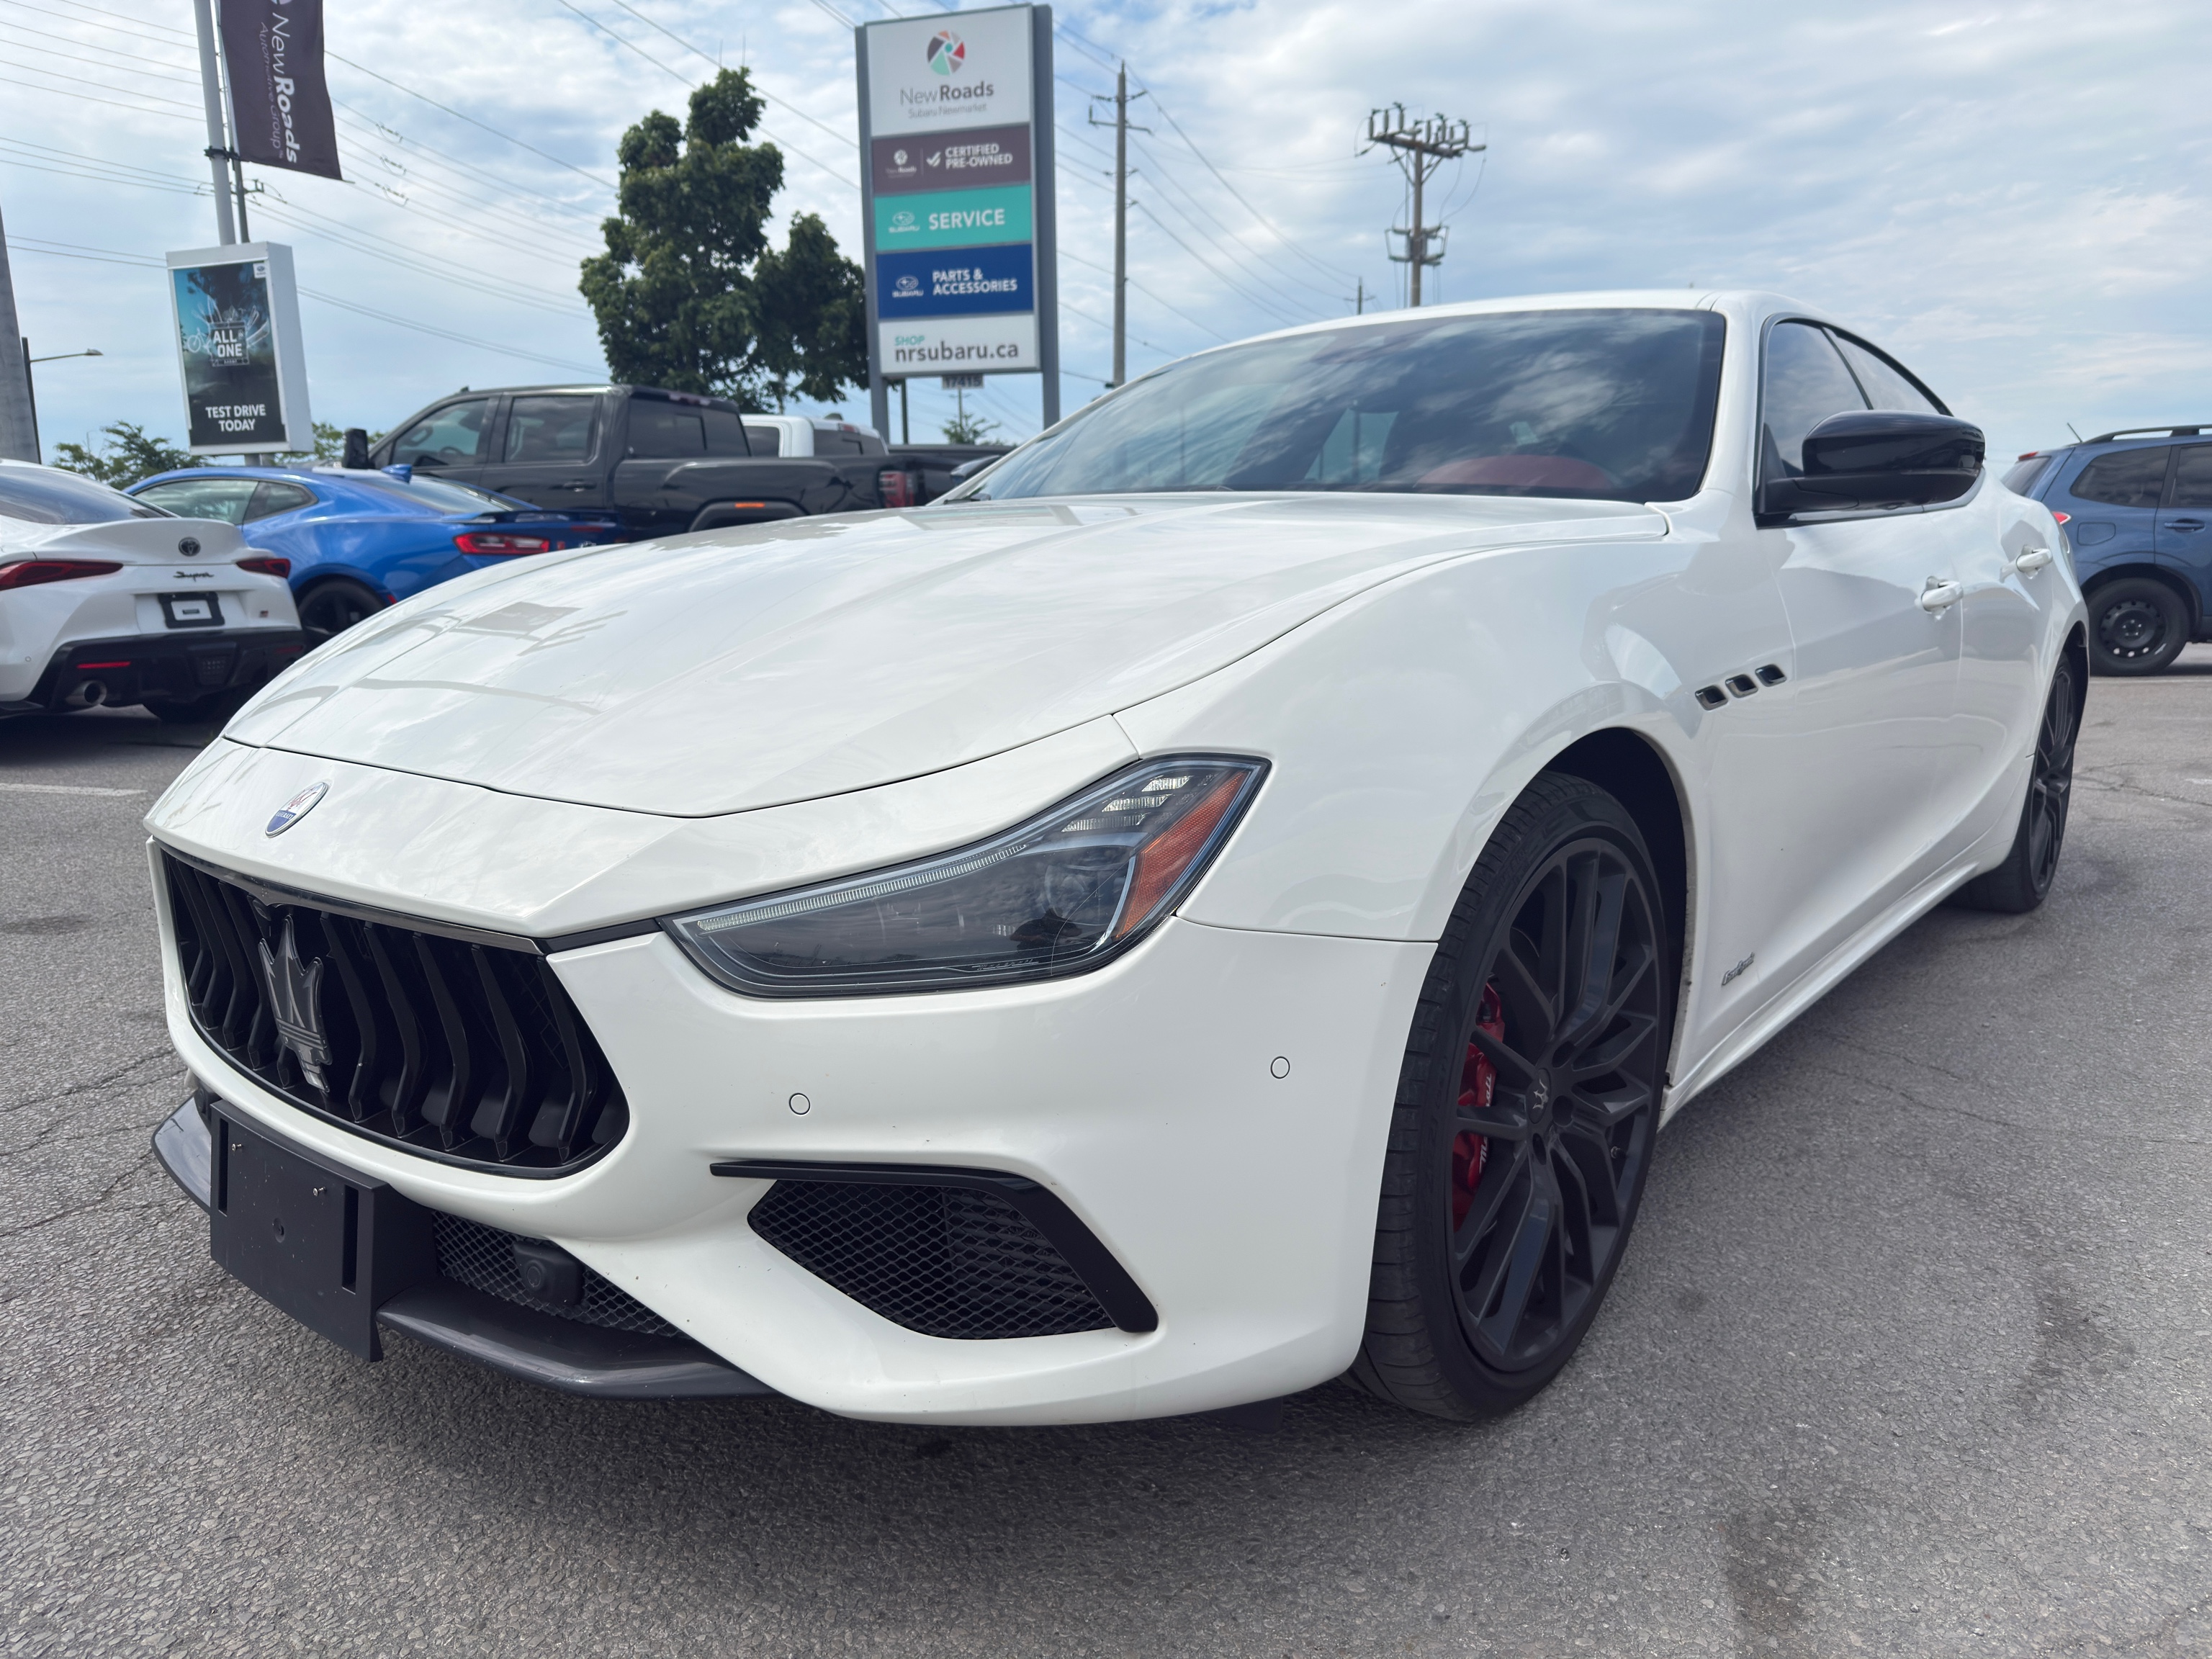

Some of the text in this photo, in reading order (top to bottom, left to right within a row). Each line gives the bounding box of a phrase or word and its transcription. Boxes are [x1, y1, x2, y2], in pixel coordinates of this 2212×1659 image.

[259, 22, 274, 102] Automotive
[900, 81, 994, 106] NewRoads
[945, 143, 999, 158] CERTIFIED
[945, 153, 1013, 169] PRE-OWNED
[929, 209, 1005, 230] SERVICE
[932, 268, 984, 282] PARTS &
[932, 279, 1017, 296] ACCESSORIES
[213, 330, 237, 343] ALL
[895, 336, 925, 346] SHOP
[217, 343, 243, 357] ONE
[895, 341, 1019, 362] nrsubaru.ca
[205, 404, 266, 418] TEST DRIVE
[218, 418, 256, 432] TODAY
